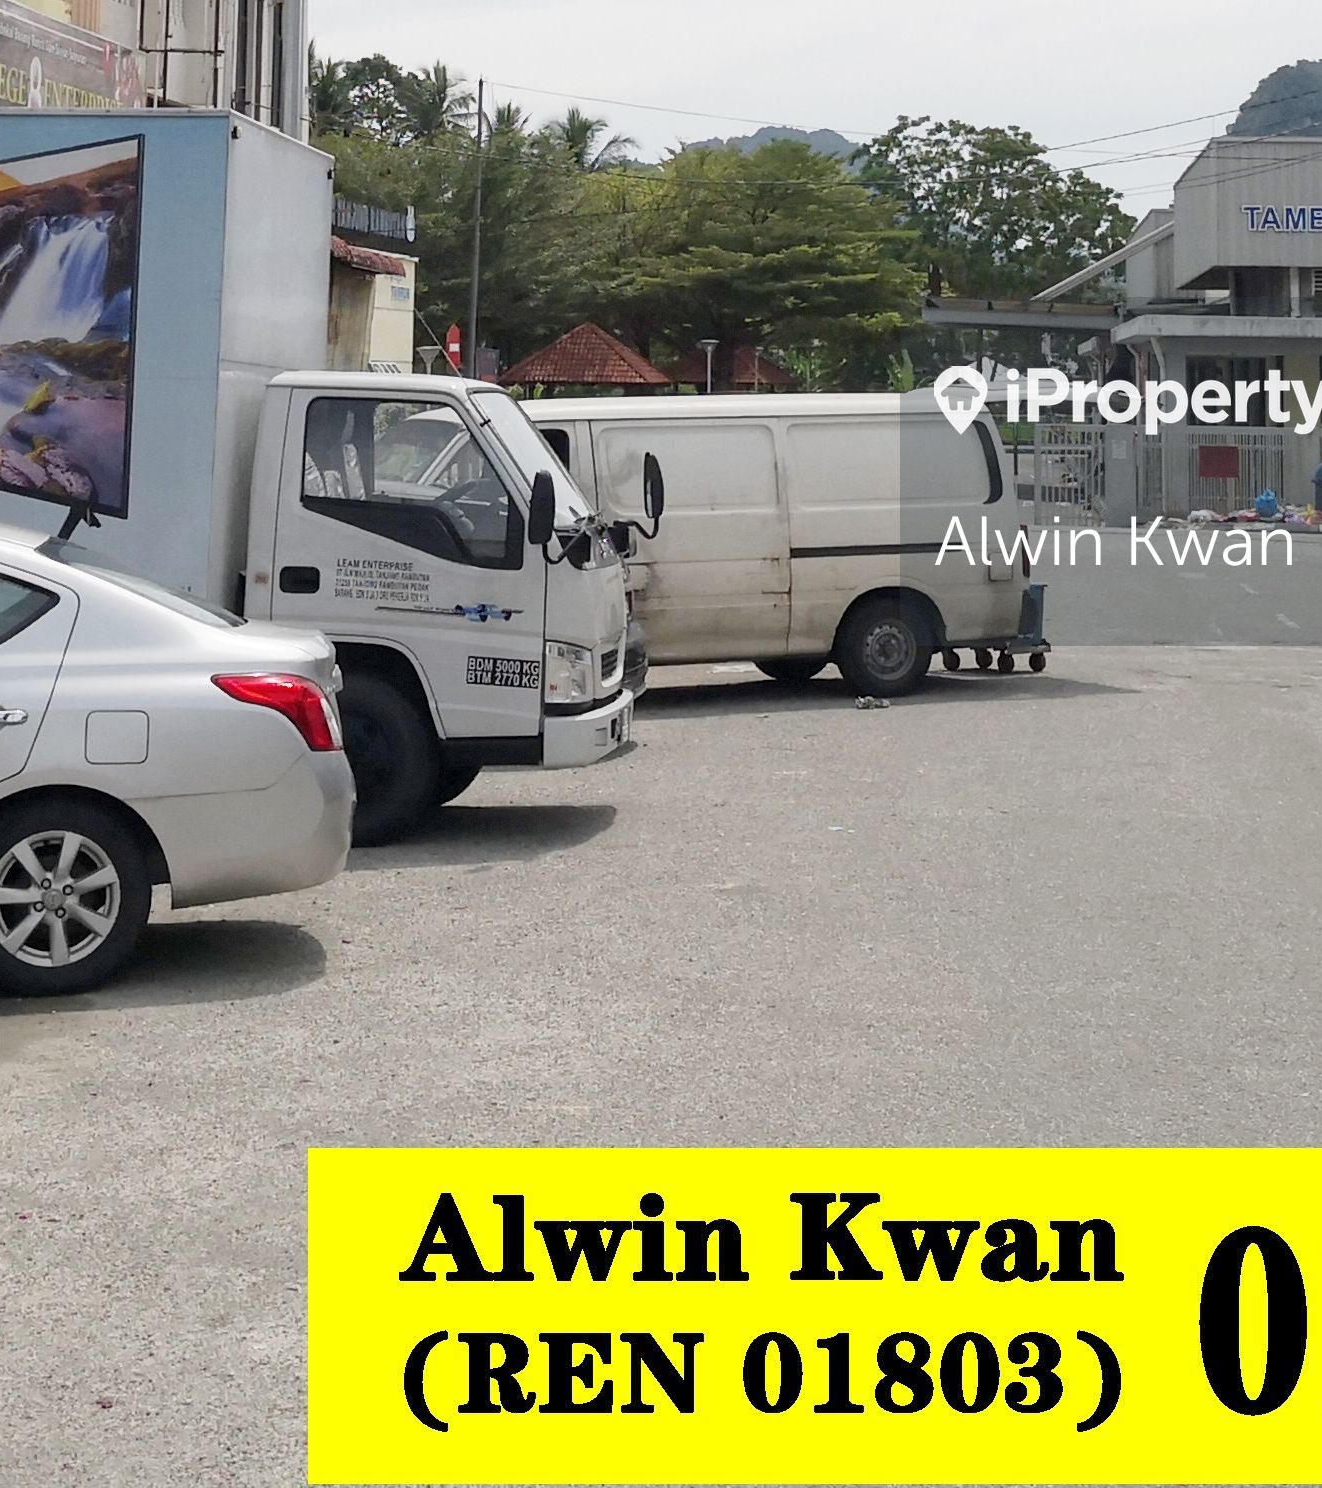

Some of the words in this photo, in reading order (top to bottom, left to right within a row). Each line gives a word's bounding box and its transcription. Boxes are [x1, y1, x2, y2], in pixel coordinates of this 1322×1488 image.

[468, 657, 493, 671] BDM
[495, 660, 521, 673] 5000
[522, 662, 539, 674] KG
[467, 670, 492, 684] BTM
[494, 672, 520, 686] 2770
[521, 674, 539, 687] KG
